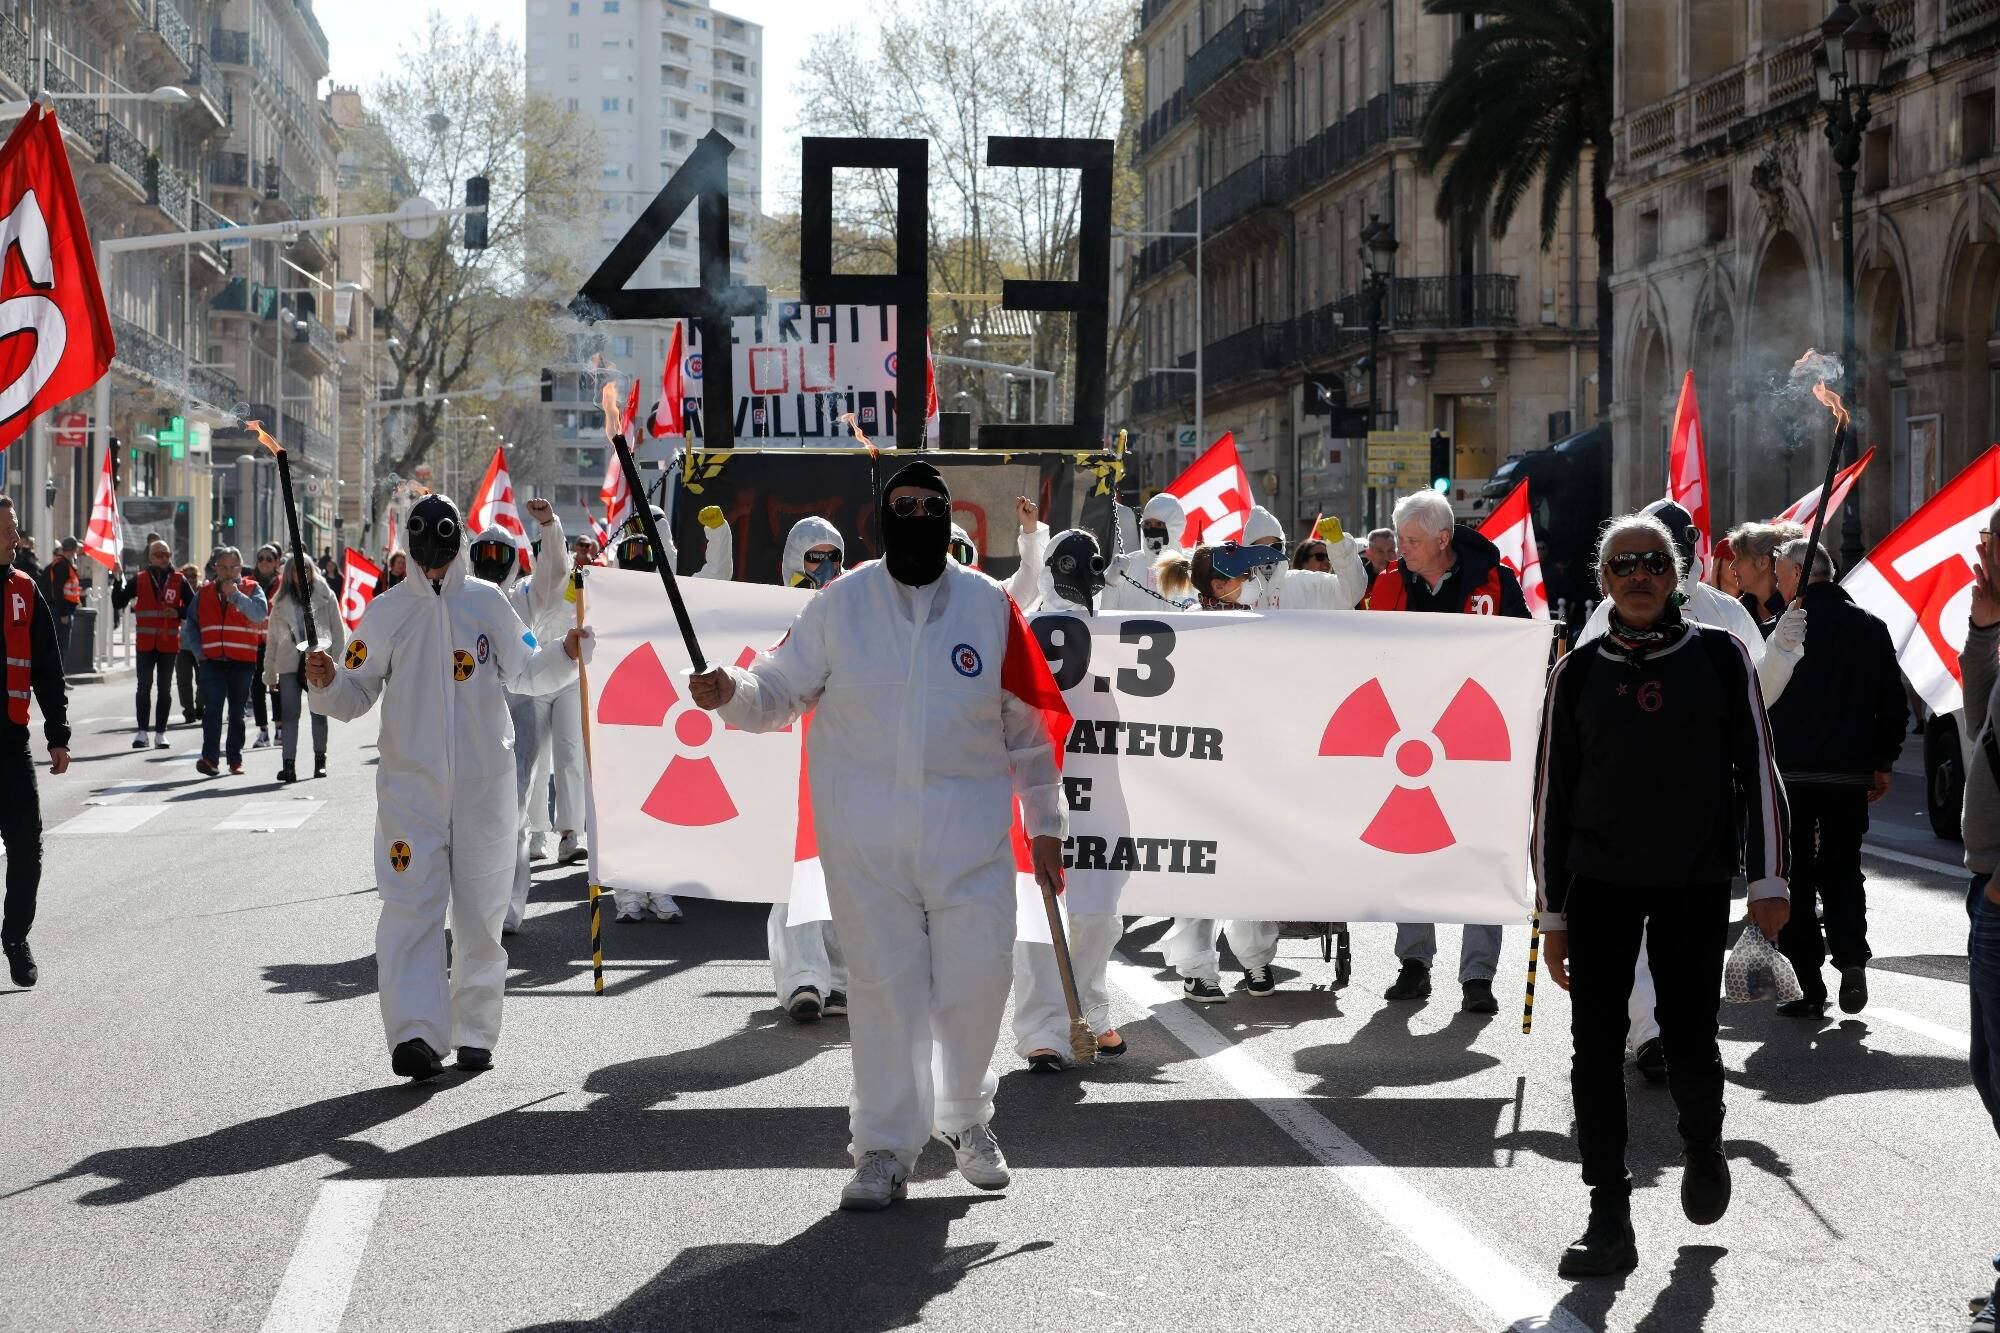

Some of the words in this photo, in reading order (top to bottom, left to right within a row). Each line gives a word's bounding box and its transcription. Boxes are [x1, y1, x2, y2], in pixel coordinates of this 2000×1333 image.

[749, 344, 835, 395] OU
[1637, 681, 1662, 712] 6
[1066, 719, 1223, 761] ATEUR
